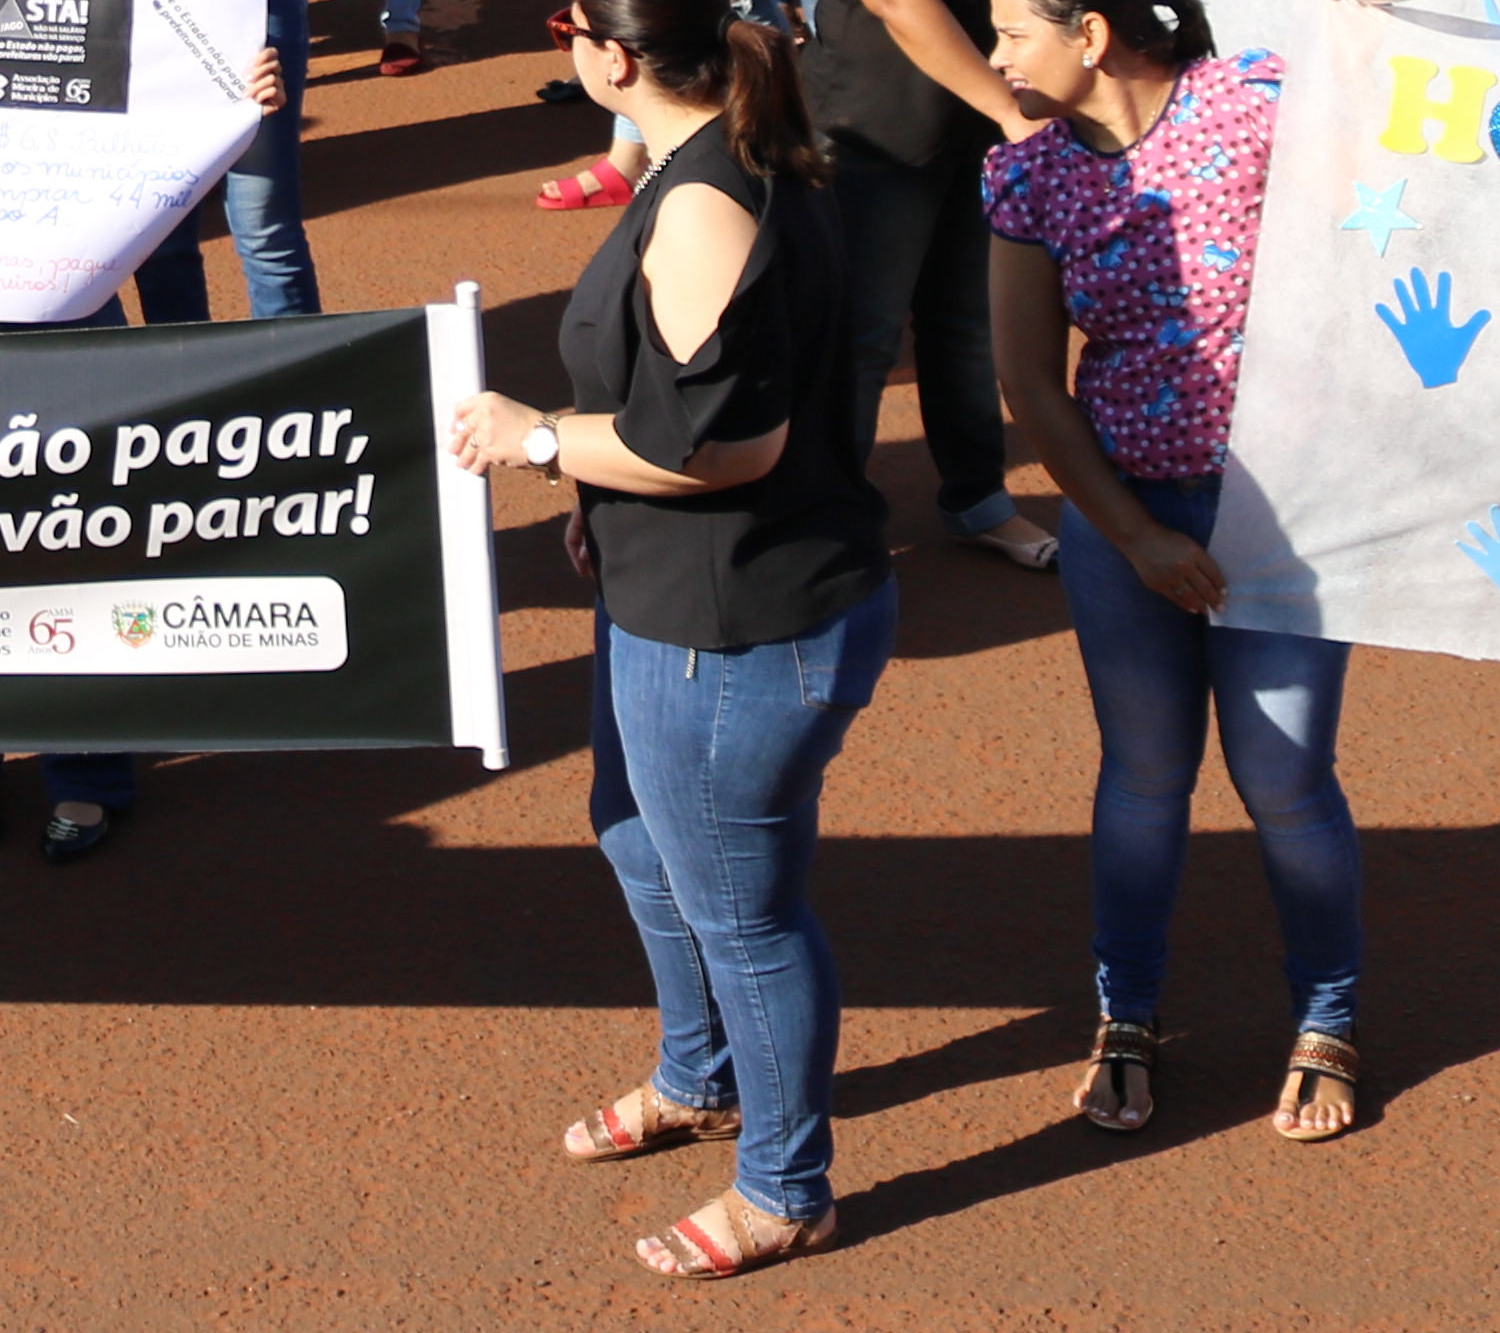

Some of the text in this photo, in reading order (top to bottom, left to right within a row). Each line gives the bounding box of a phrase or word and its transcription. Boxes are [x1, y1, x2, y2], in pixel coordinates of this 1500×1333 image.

[112, 407, 370, 486] pagar,
[146, 474, 375, 558] parar!
[28, 609, 77, 656] 65
[162, 595, 319, 630] CÂMARA
[163, 630, 319, 649] UNIÃO DE MINAS
